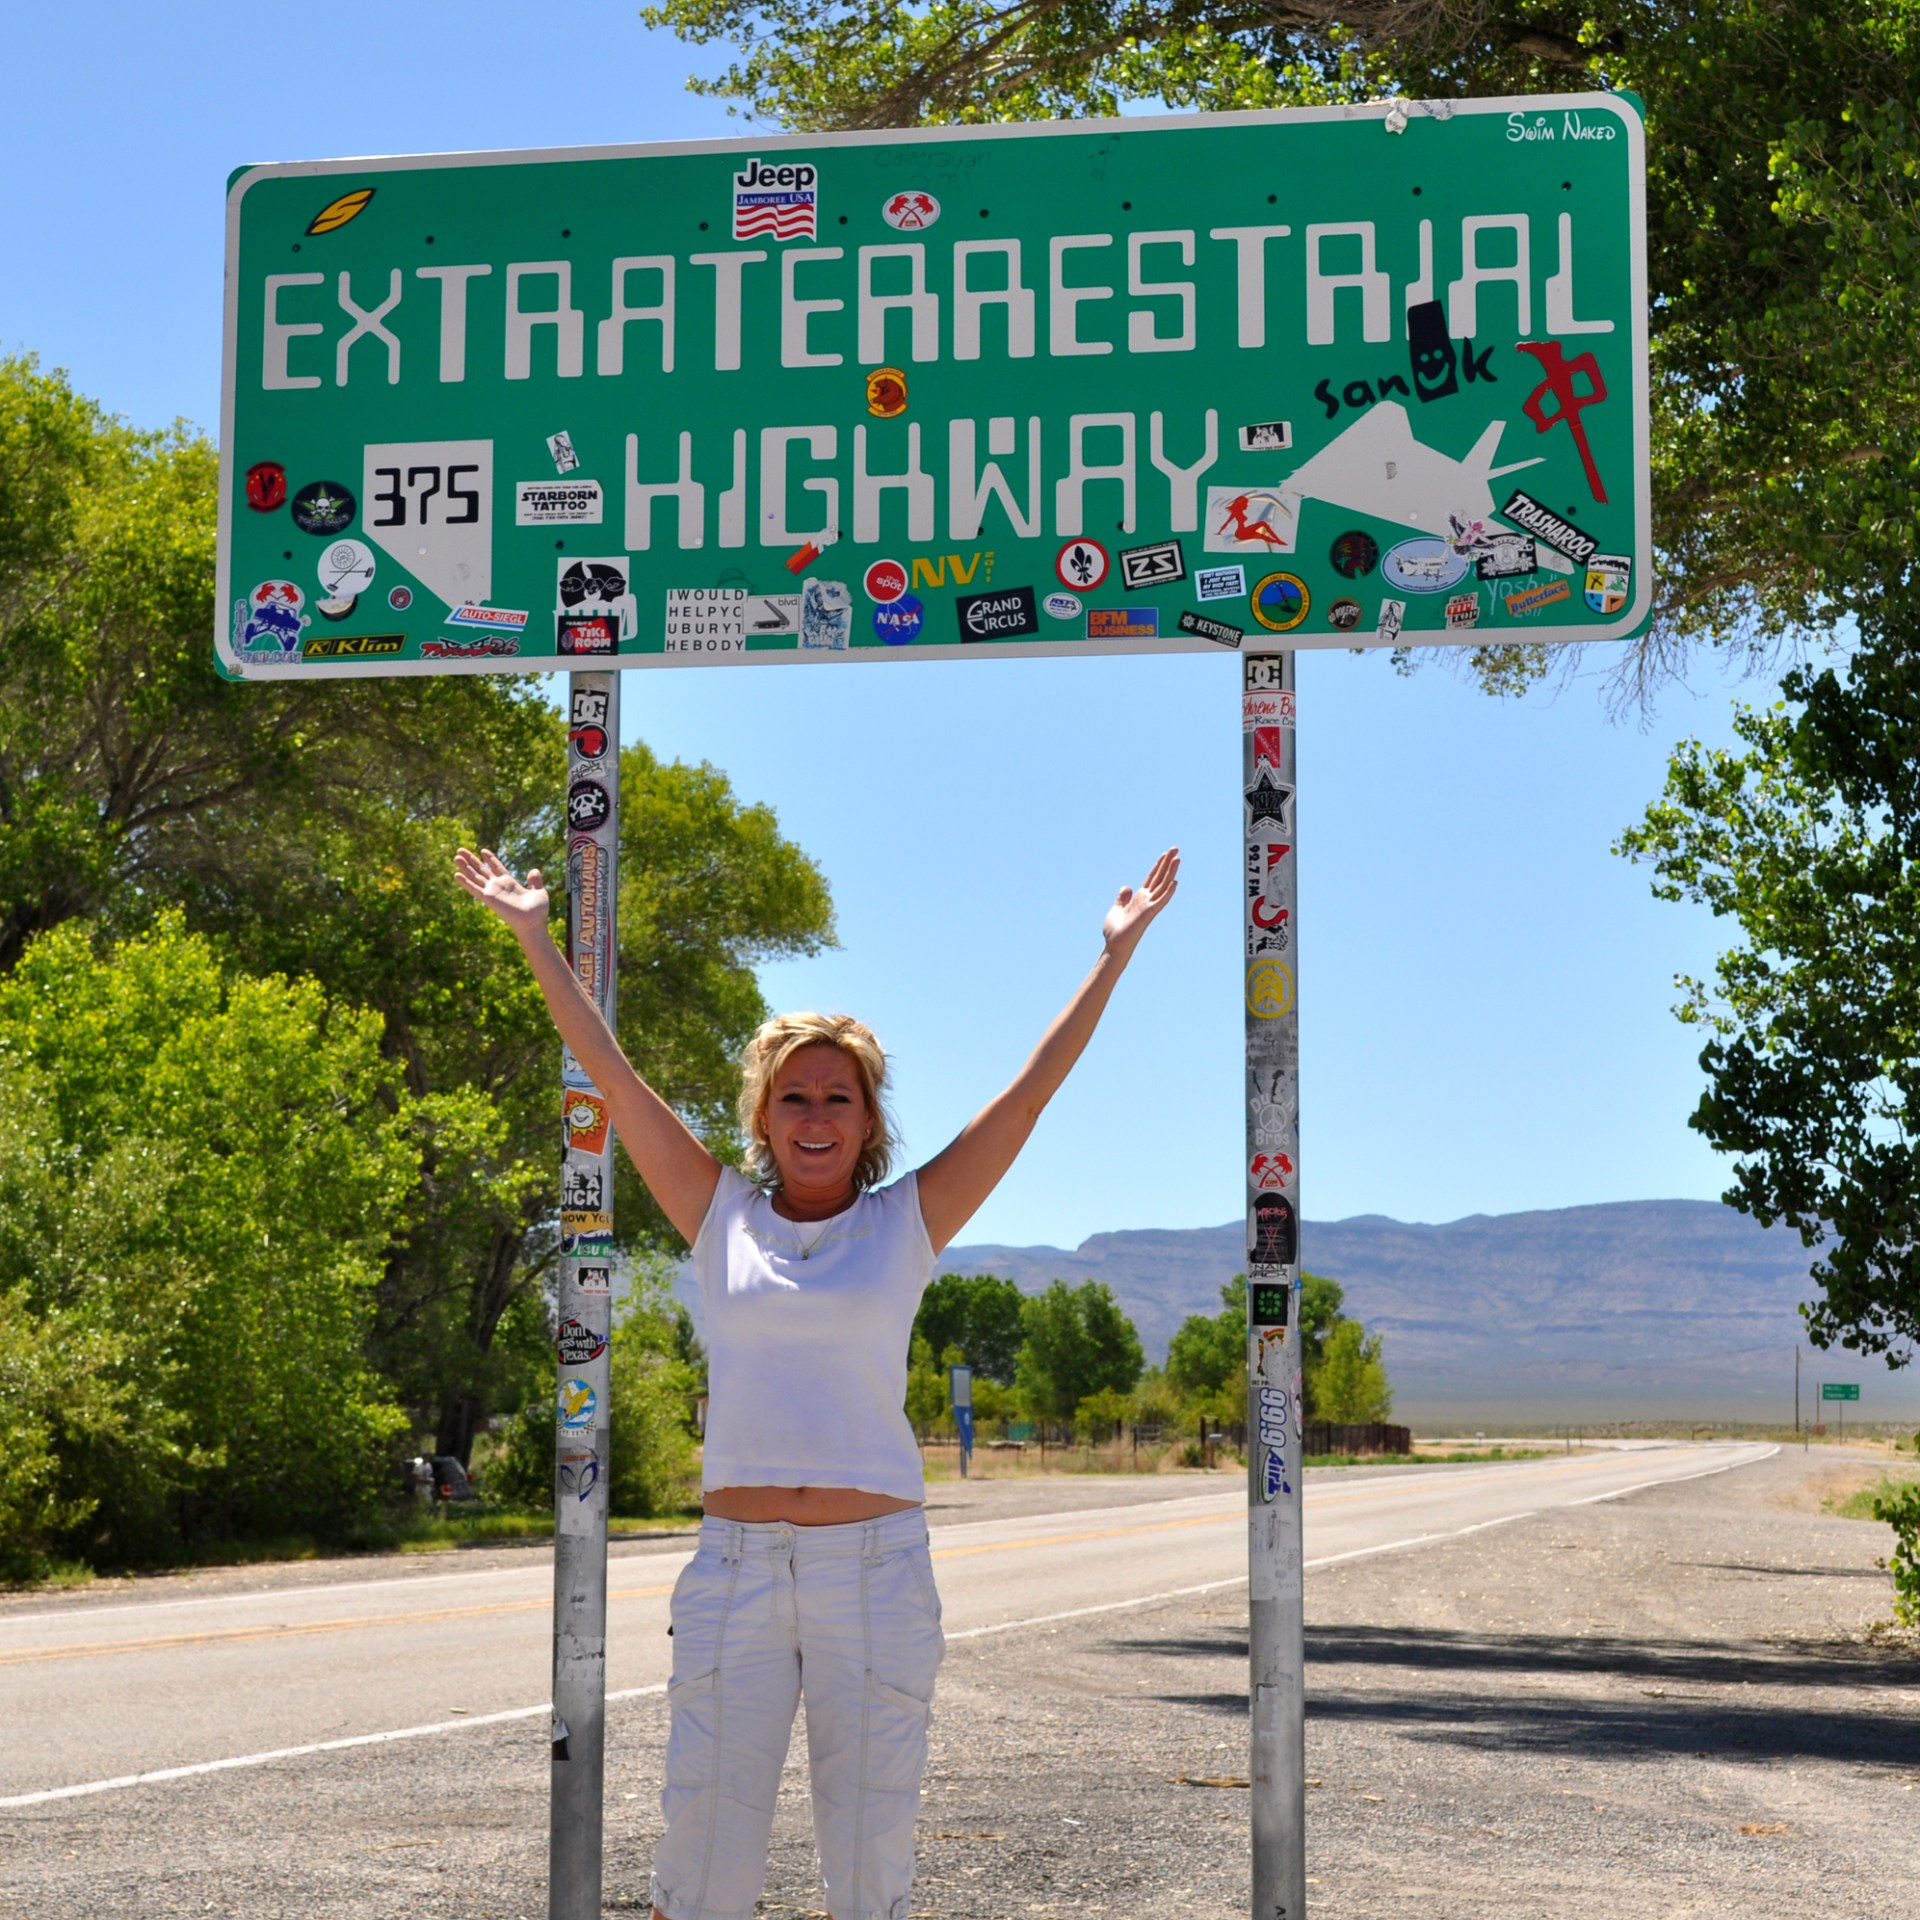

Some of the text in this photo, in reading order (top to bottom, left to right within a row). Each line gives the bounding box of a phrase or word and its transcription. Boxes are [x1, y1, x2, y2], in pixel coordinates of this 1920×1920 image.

[737, 162, 815, 191] Jeep
[789, 194, 812, 203] USA
[262, 212, 1616, 390] EXTRATERRESTRIAL
[624, 408, 1219, 551] HIGHWAY
[372, 464, 480, 527] 375
[521, 490, 598, 501] STARBORN
[531, 501, 587, 511] TATTOO
[1504, 494, 1595, 557] TRASHAROO
[912, 552, 981, 590] NV
[876, 577, 903, 591] spot
[1510, 584, 1568, 613] Butterface
[461, 608, 525, 623] AUTO-SIEGL
[877, 612, 920, 630] NASA
[1090, 611, 1128, 625] BFM
[1452, 612, 1477, 623] TOP
[1090, 624, 1155, 636] BUSINESS
[1196, 619, 1242, 643] KEYSTONE
[575, 638, 611, 648] ROOM
[1249, 844, 1260, 897] 92.7 FM
[579, 846, 598, 947] AUTOHAUS
[575, 1336, 596, 1349] with
[1259, 1387, 1287, 1448] 99.9
